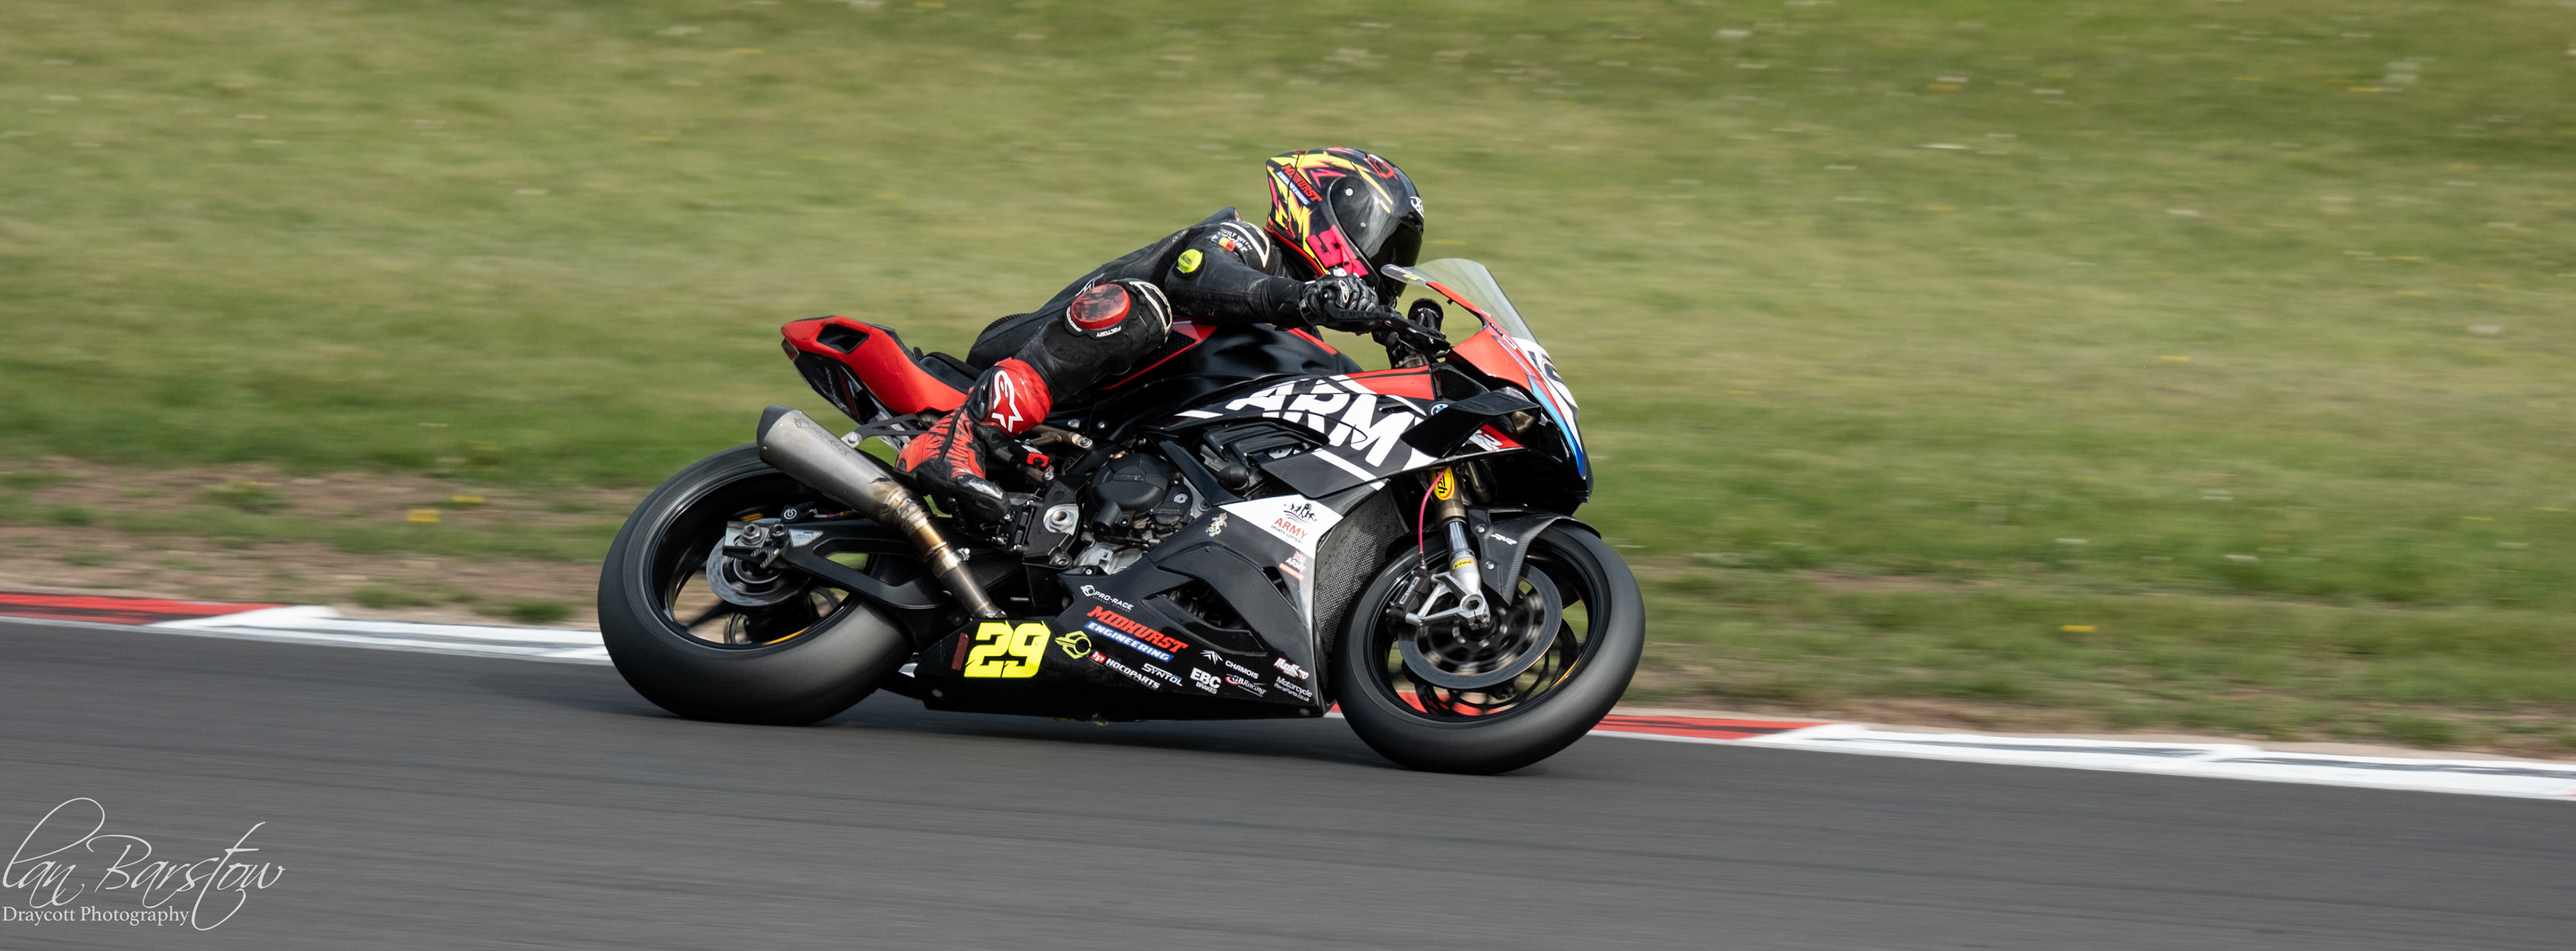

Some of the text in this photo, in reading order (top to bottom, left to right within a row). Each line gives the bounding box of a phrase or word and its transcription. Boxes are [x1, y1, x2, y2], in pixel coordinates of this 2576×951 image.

[1274, 518, 1308, 539] ARMY
[1285, 557, 1307, 572] ARMY
[1094, 591, 1134, 611] PRO-RACE
[1086, 606, 1189, 653] MIDHURST
[964, 620, 1051, 678] 29
[1087, 622, 1170, 661] ENGINEERING
[1106, 659, 1161, 689] HOCOPARTS
[1141, 663, 1183, 687] SYNTOL
[1190, 667, 1222, 689] EBC
[1225, 660, 1259, 679] CHAMOIS
[1195, 681, 1218, 695] BRAKES
[1276, 676, 1313, 698] Motorcycle
